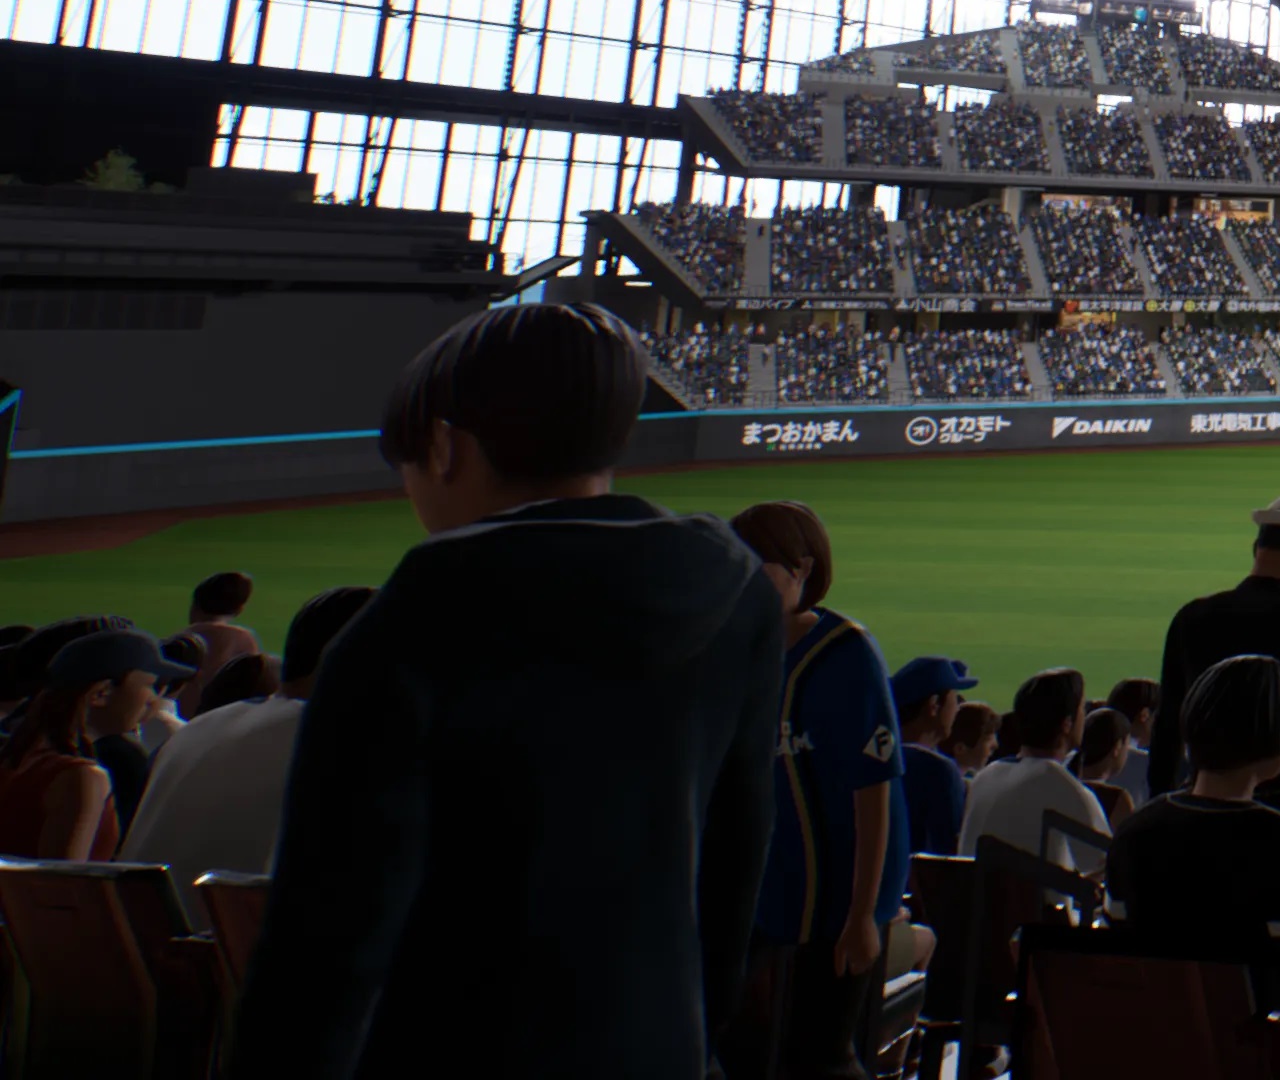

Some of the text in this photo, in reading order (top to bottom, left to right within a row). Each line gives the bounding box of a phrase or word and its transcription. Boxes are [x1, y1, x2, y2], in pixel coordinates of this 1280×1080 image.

[742, 420, 859, 445] まつおかまん
[939, 415, 1011, 433] オカモト
[1073, 417, 1152, 435] DAIKIN
[938, 431, 988, 444] グループ
